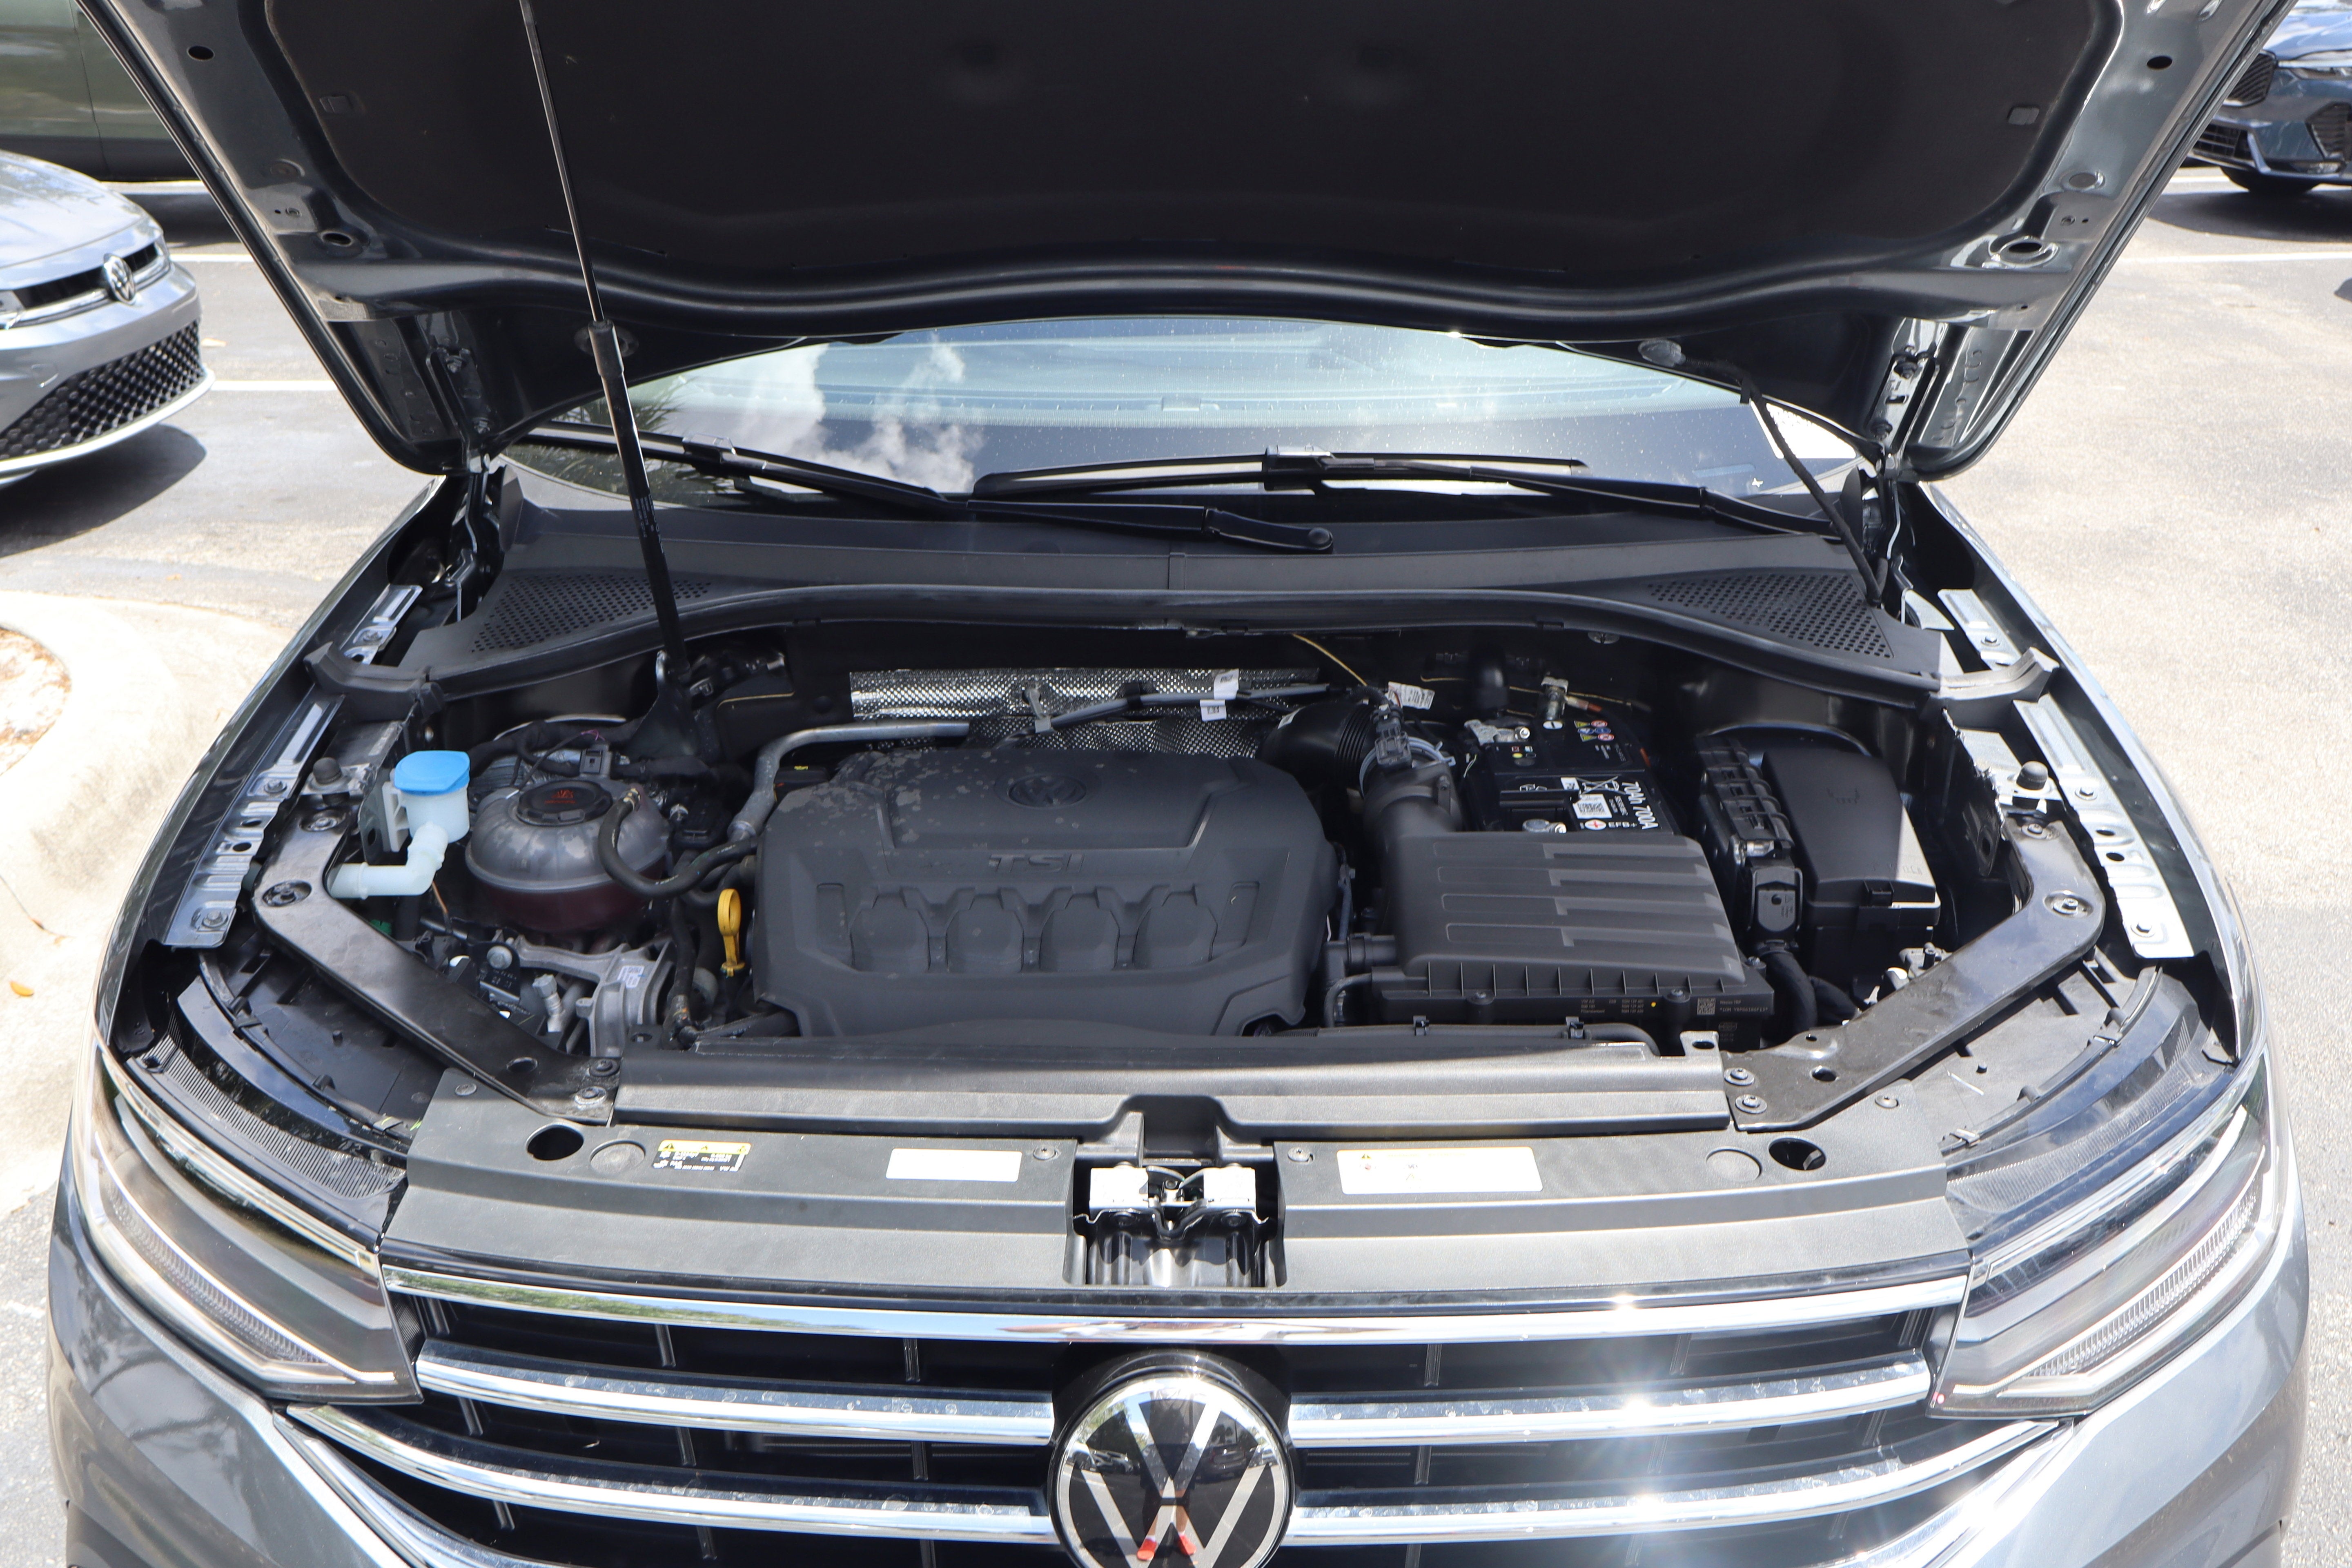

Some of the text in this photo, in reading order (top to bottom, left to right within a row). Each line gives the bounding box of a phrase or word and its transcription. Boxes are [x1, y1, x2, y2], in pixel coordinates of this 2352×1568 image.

[1622, 781, 1646, 804] 70Ah
[1633, 805, 1659, 830] 700A
[989, 853, 1085, 872] TSI
[1064, 1384, 1279, 1568] VW
